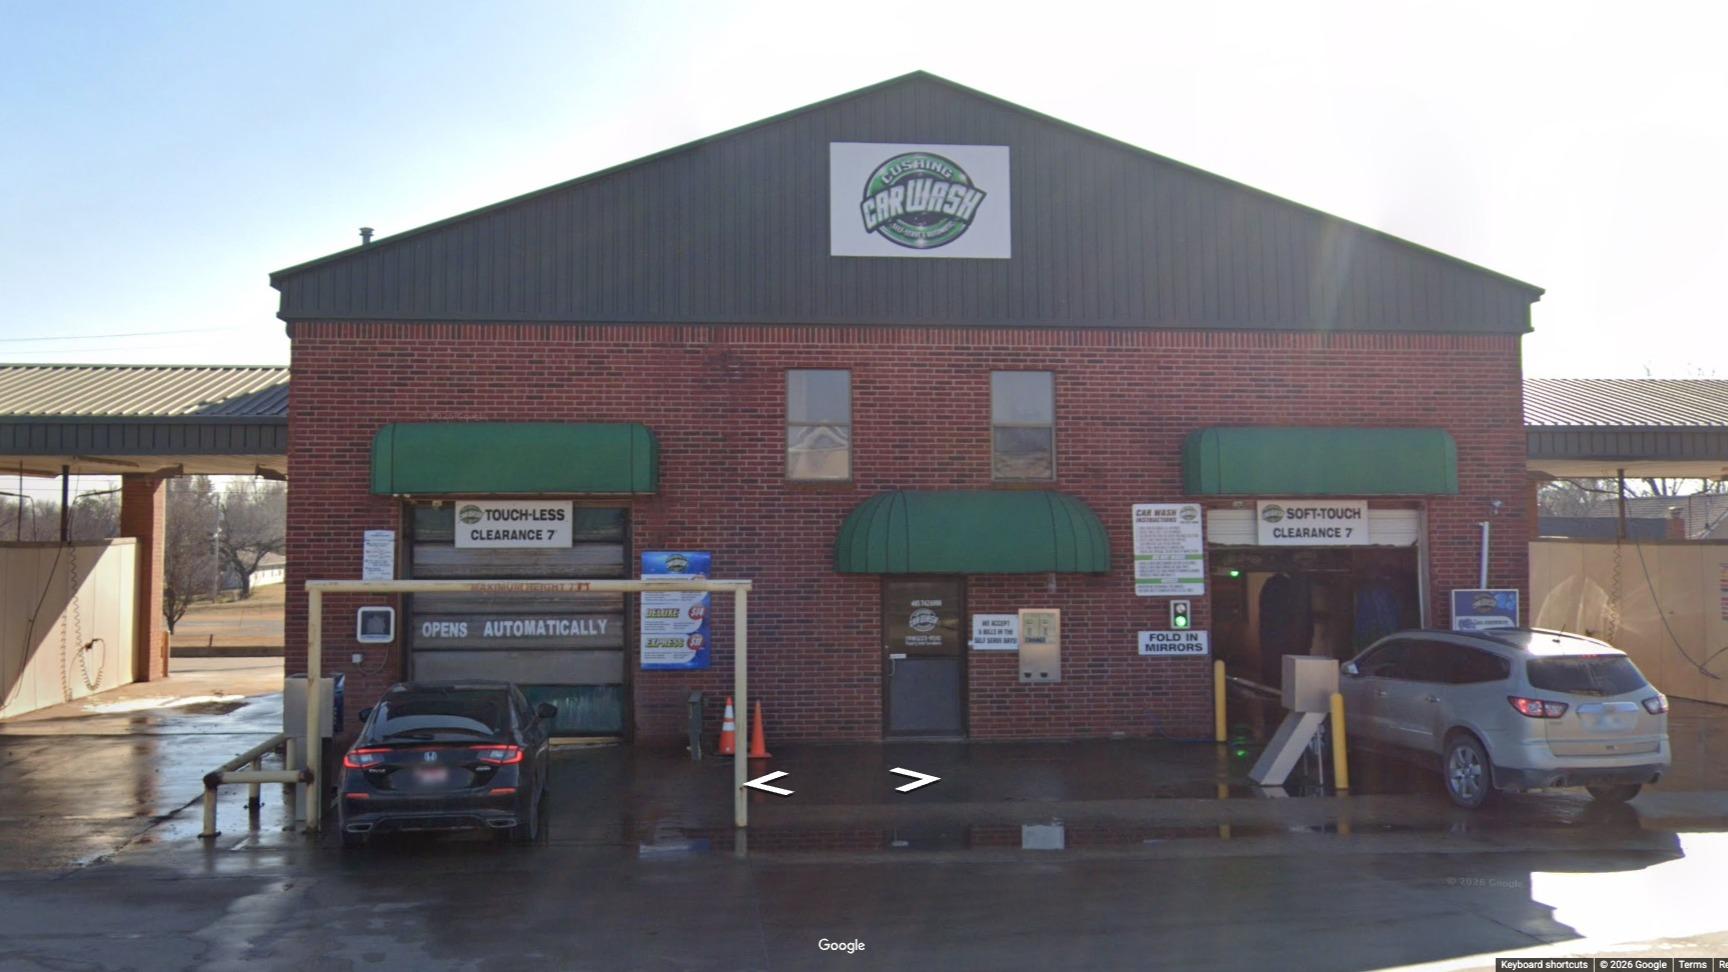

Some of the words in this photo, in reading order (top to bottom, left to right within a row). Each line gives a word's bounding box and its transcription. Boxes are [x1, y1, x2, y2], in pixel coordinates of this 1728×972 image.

[881, 159, 953, 184] CUSHING
[862, 184, 905, 230] CAR
[905, 178, 982, 220] WASH
[485, 508, 565, 521] TOUCH-LESS
[1286, 508, 1361, 519] SOFT-TOUCH
[471, 529, 543, 540] CLEARANCE
[1273, 528, 1341, 538] CLEARANCE
[422, 622, 468, 638] OPENS
[483, 619, 608, 637] AUTOMATICALLY
[1149, 633, 1181, 642] FOLD
[1186, 633, 1198, 642] IN
[1145, 643, 1203, 652] MIRRORS
